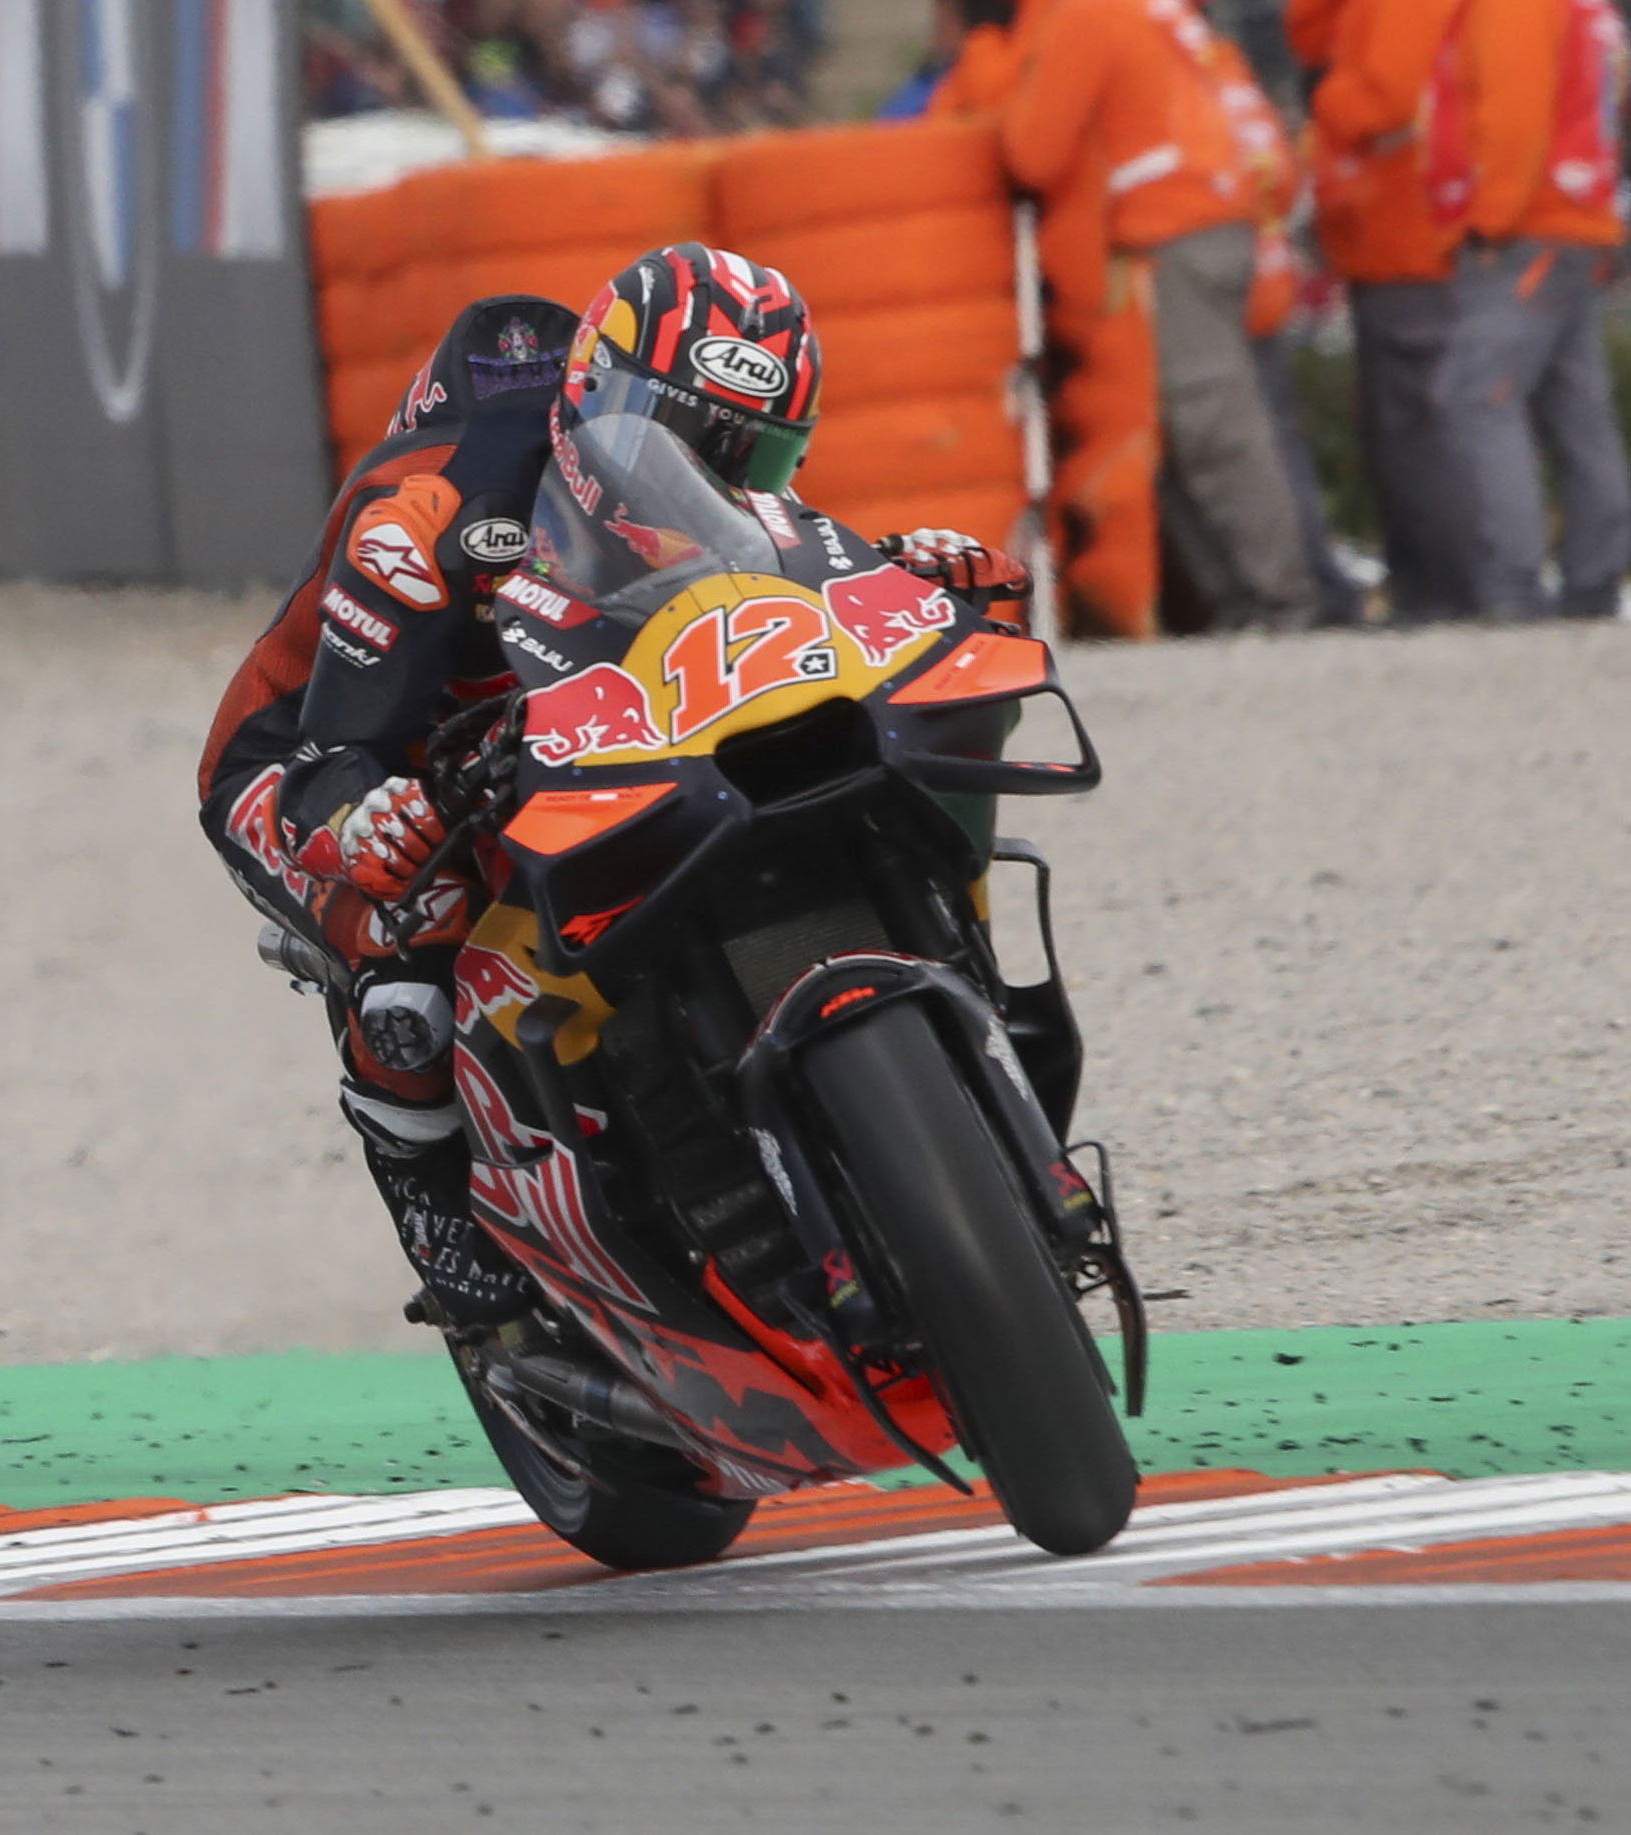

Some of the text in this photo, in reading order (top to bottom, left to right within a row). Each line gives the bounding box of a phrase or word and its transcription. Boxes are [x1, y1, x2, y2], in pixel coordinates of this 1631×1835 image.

[701, 346, 777, 385] Arai
[648, 377, 699, 407] GIVES
[708, 402, 746, 426] YOU
[471, 525, 525, 550] Arai
[323, 587, 392, 647] MOTUL
[496, 574, 571, 622] MOTUL
[519, 637, 574, 672] BAJAJ
[662, 595, 832, 746] 12
